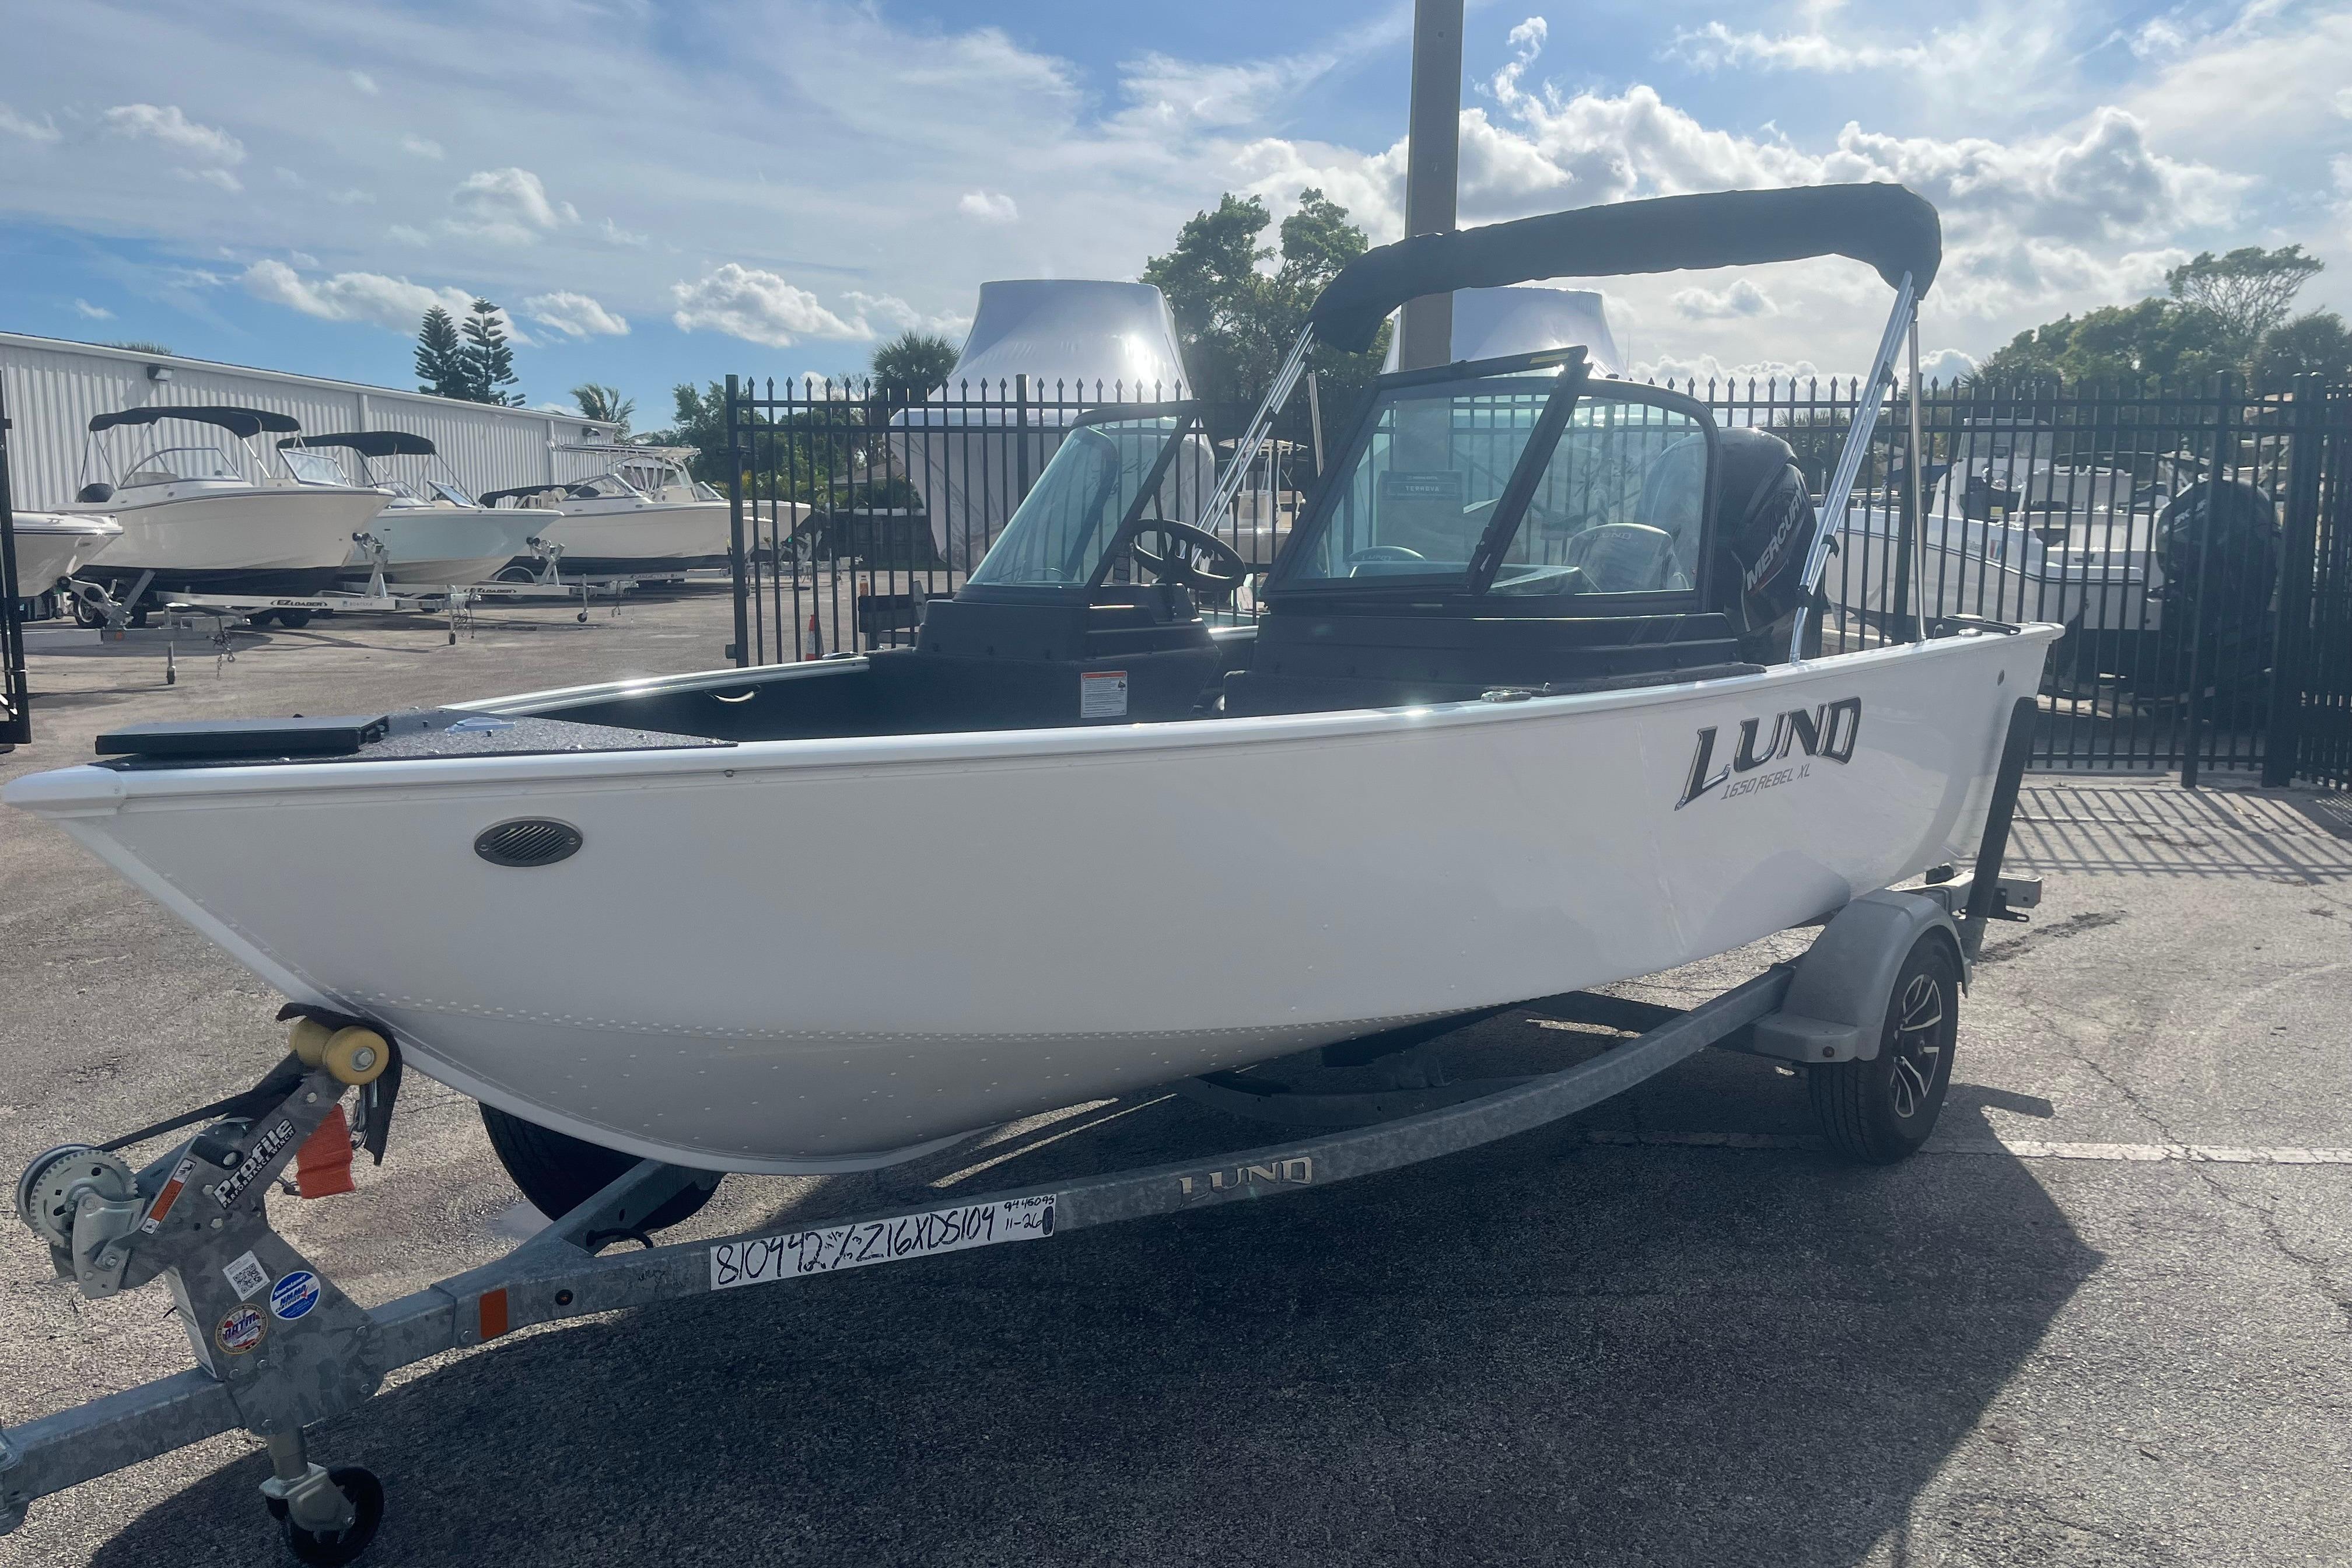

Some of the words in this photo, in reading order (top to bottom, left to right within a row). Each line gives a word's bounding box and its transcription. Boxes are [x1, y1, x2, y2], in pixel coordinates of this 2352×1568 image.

[1746, 488, 1803, 591] MERCURY
[1674, 695, 1862, 811] LUND
[1720, 777, 1758, 800] 1650
[1754, 767, 1793, 796] REBEL
[1797, 762, 1811, 780] XL
[214, 1118, 294, 1205] Profile
[222, 1154, 272, 1209] PERFORMANCE
[270, 1129, 295, 1155] WINCH
[1172, 1156, 1312, 1211] LUND
